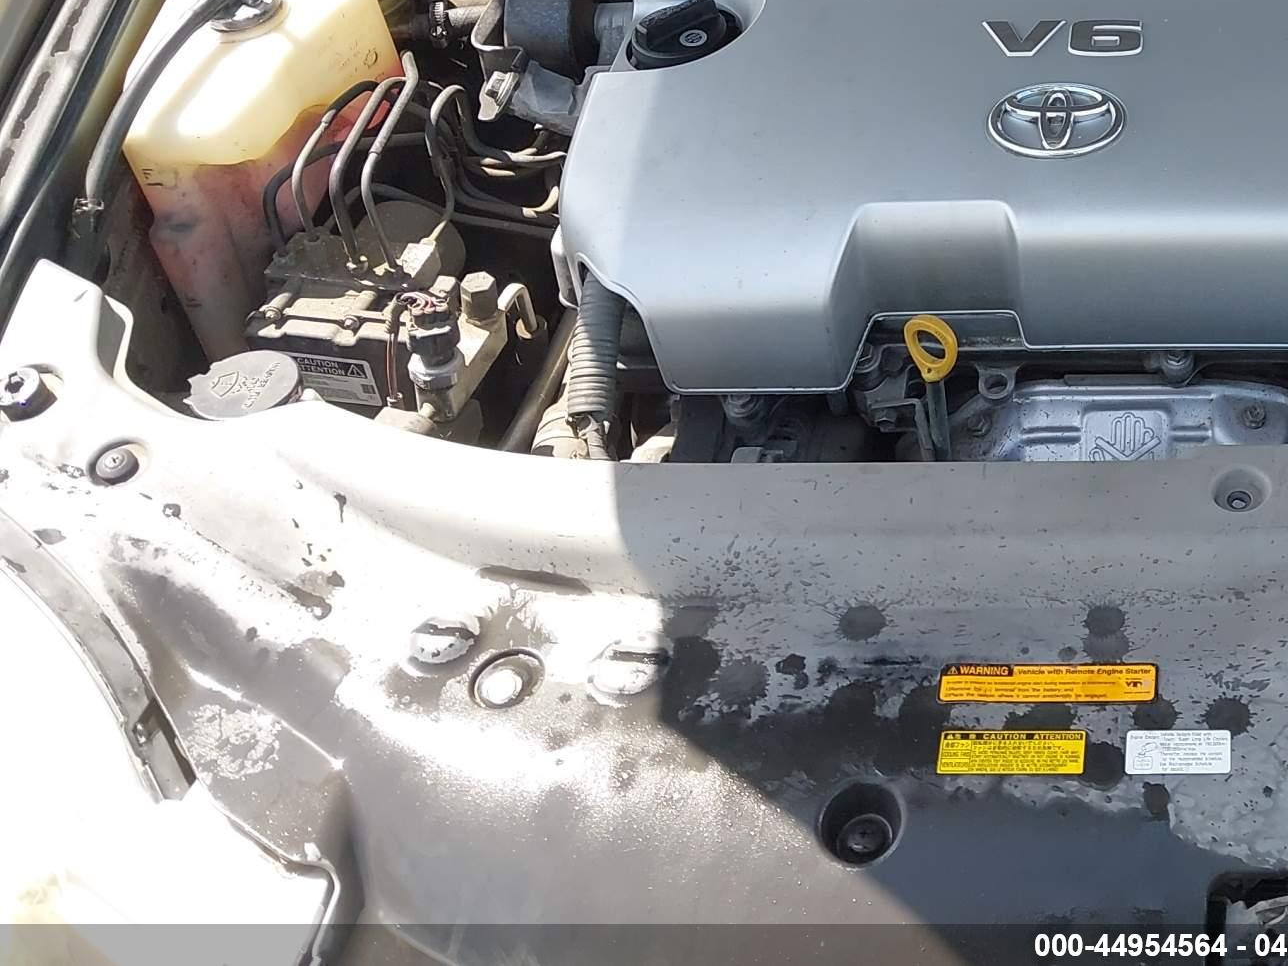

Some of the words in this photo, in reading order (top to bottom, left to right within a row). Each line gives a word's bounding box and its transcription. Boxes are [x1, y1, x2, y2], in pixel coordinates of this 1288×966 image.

[981, 19, 1145, 57] V6
[297, 357, 339, 369] CAUTION
[960, 665, 1009, 676] WARNING
[1047, 667, 1063, 675] with
[1065, 667, 1095, 675] Remote
[1096, 668, 1124, 676] Engine
